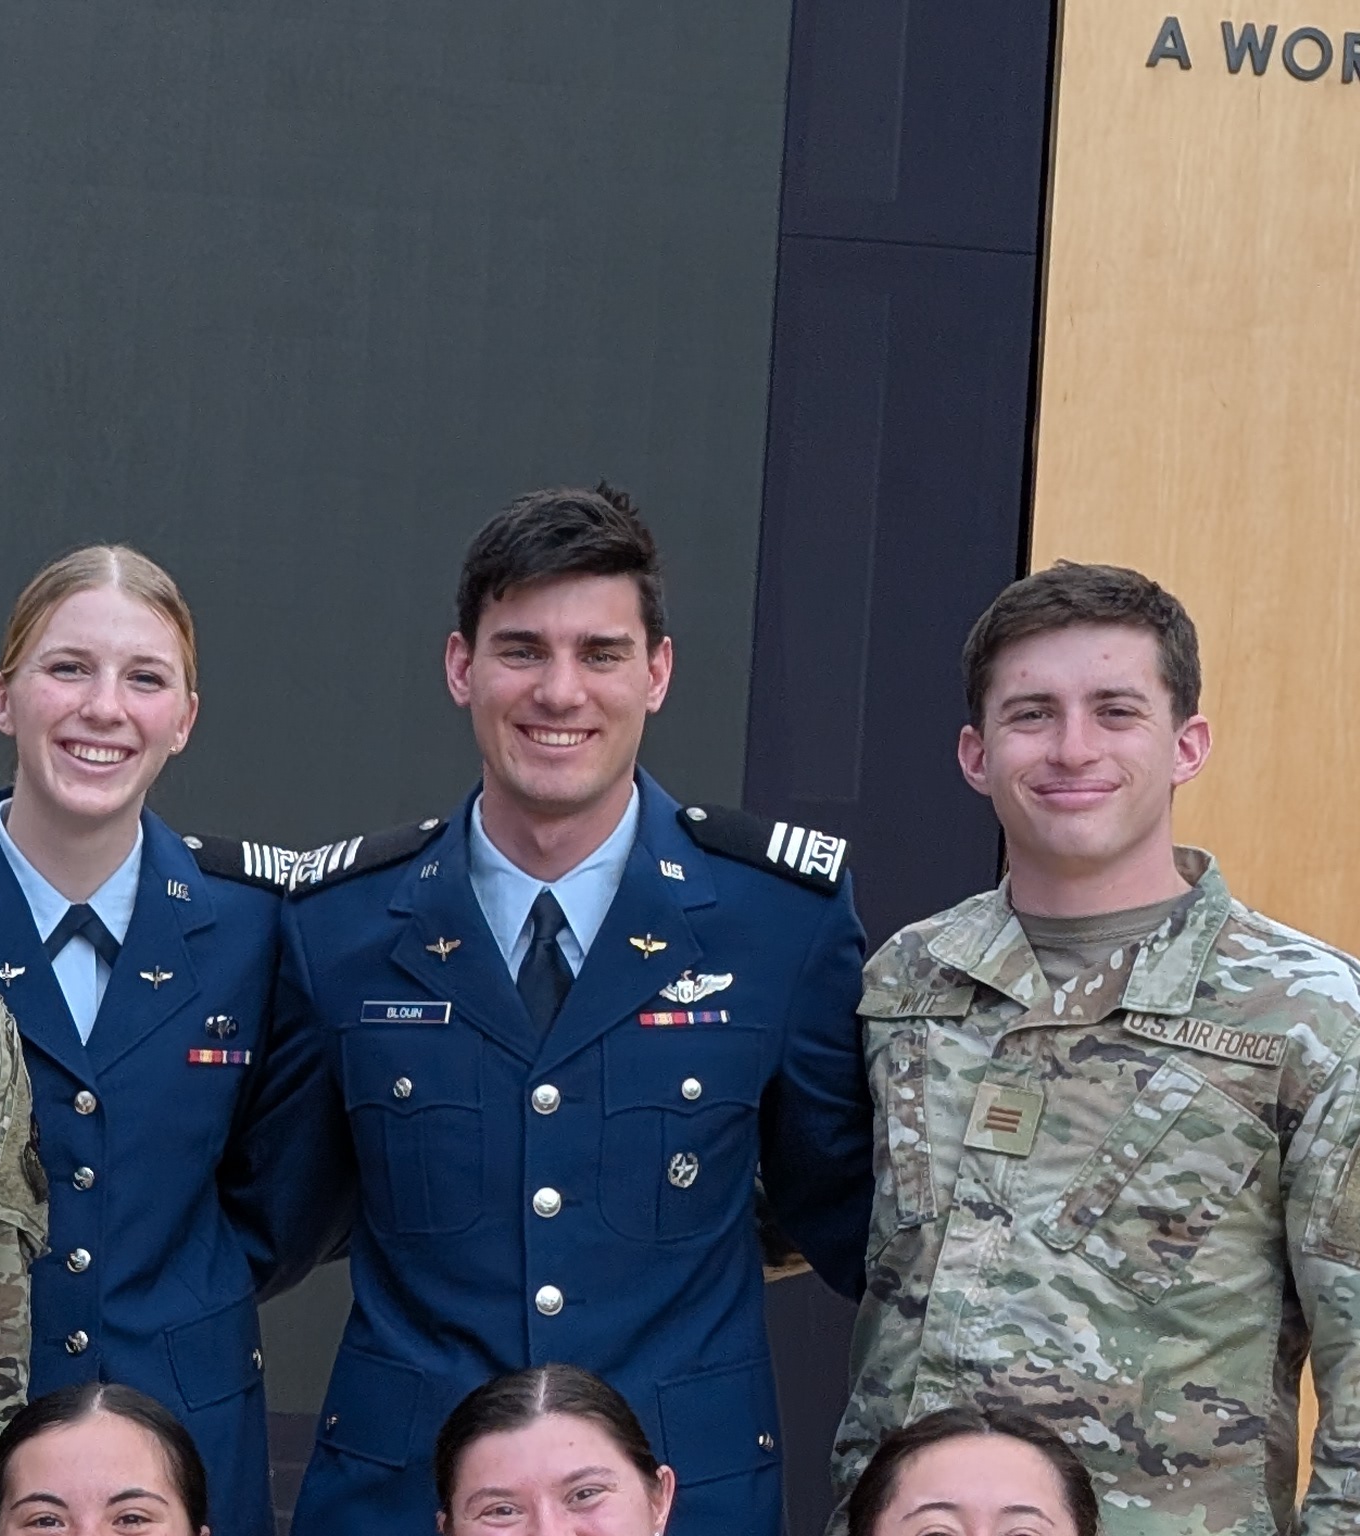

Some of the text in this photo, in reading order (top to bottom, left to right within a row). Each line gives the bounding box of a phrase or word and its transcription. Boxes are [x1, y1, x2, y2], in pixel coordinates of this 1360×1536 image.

[1145, 16, 1192, 70] A
[1130, 1014, 1281, 1062] U.S. AIR FORCE
